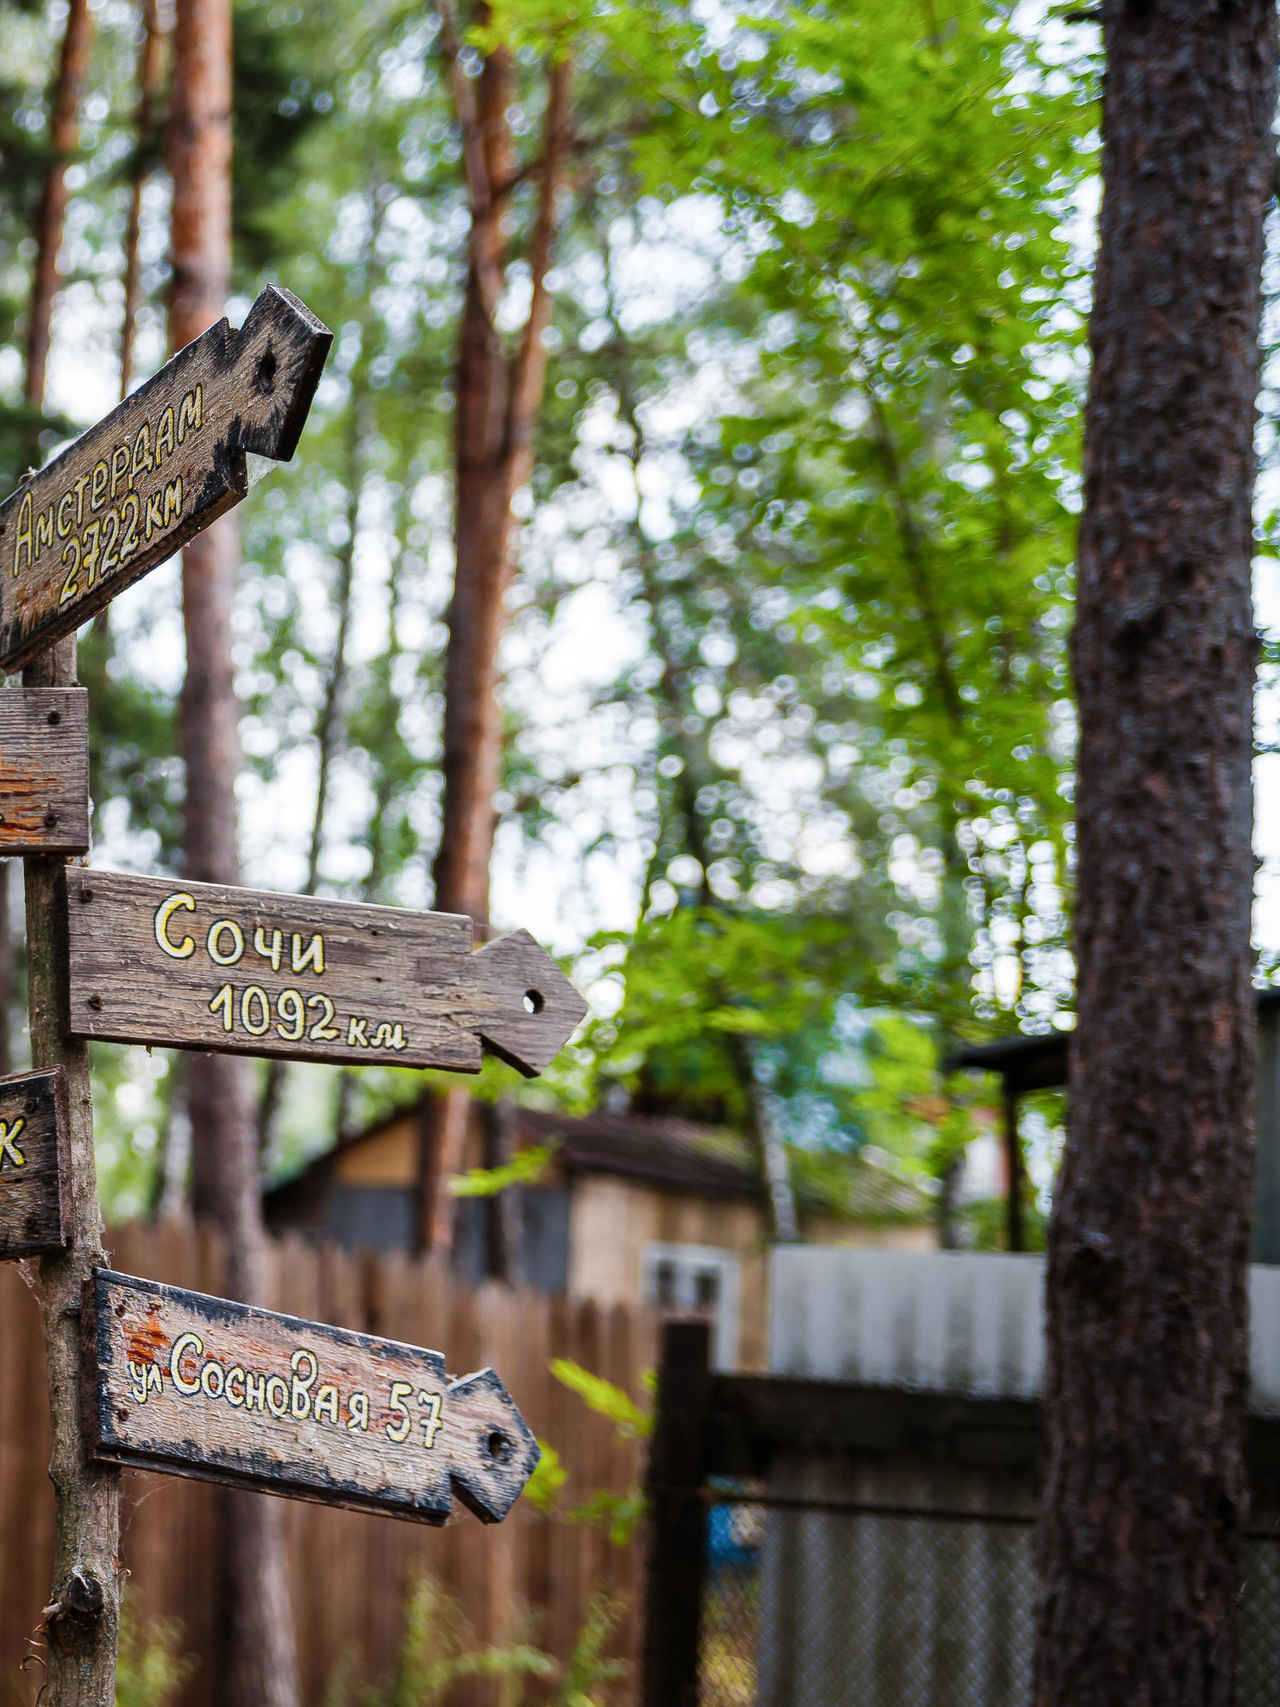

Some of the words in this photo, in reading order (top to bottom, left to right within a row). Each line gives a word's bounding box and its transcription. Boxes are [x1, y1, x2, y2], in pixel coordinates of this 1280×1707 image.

[154, 892, 325, 975] Сочи
[209, 983, 339, 1040] 1092
[385, 1381, 443, 1449] 57
